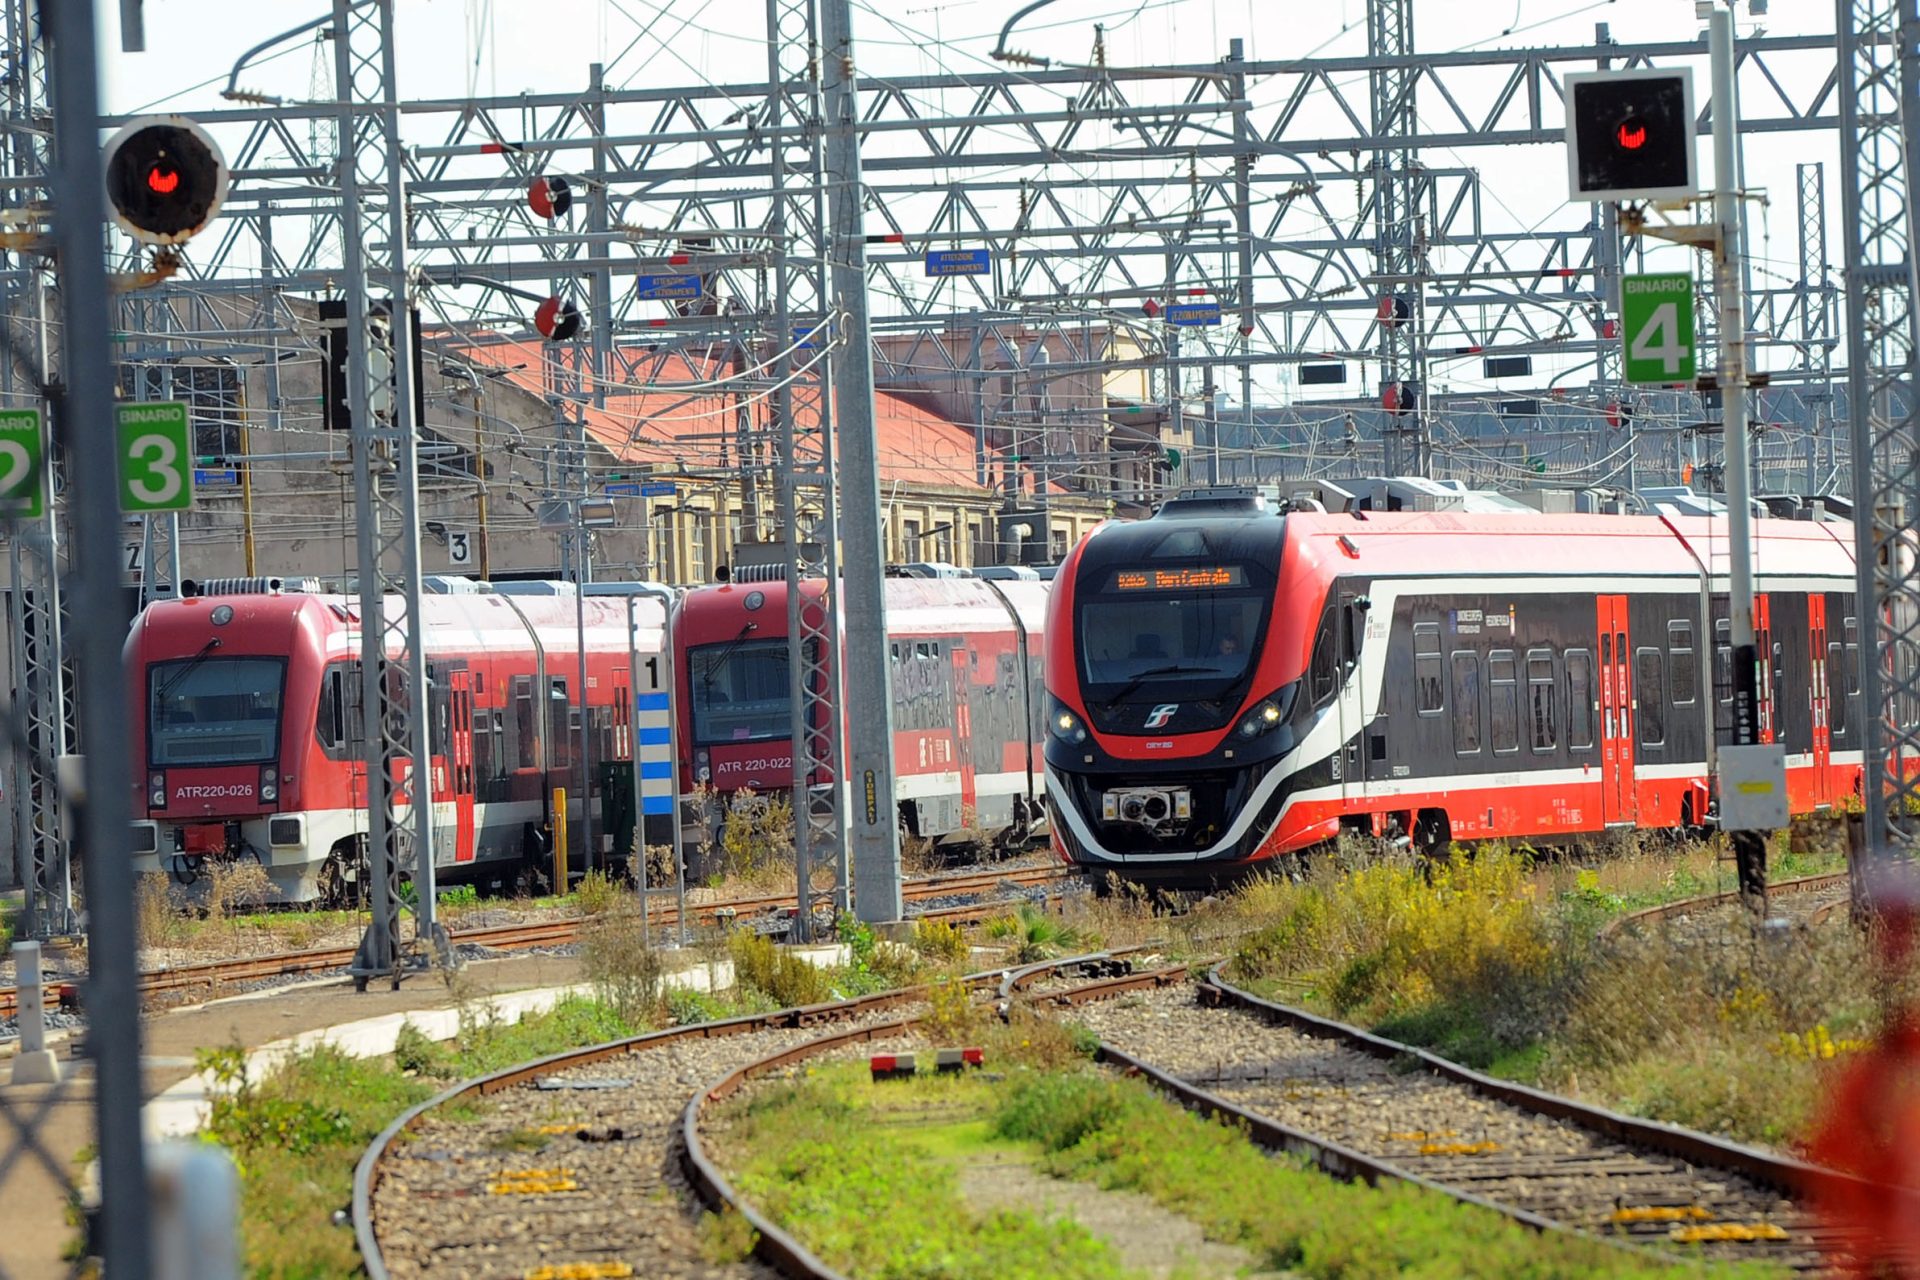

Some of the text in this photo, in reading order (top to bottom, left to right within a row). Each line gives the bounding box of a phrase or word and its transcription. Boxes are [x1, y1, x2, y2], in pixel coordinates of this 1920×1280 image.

[1626, 278, 1688, 294] BINARIO
[1631, 302, 1689, 374] 4
[119, 407, 182, 424] BINARIO
[0, 439, 33, 510] 2
[128, 434, 182, 504] 3
[126, 543, 141, 570] 2
[452, 533, 467, 562] 3
[645, 657, 658, 689] 1
[717, 757, 792, 774] ATR 220-022
[176, 784, 253, 799] ATR220-026
